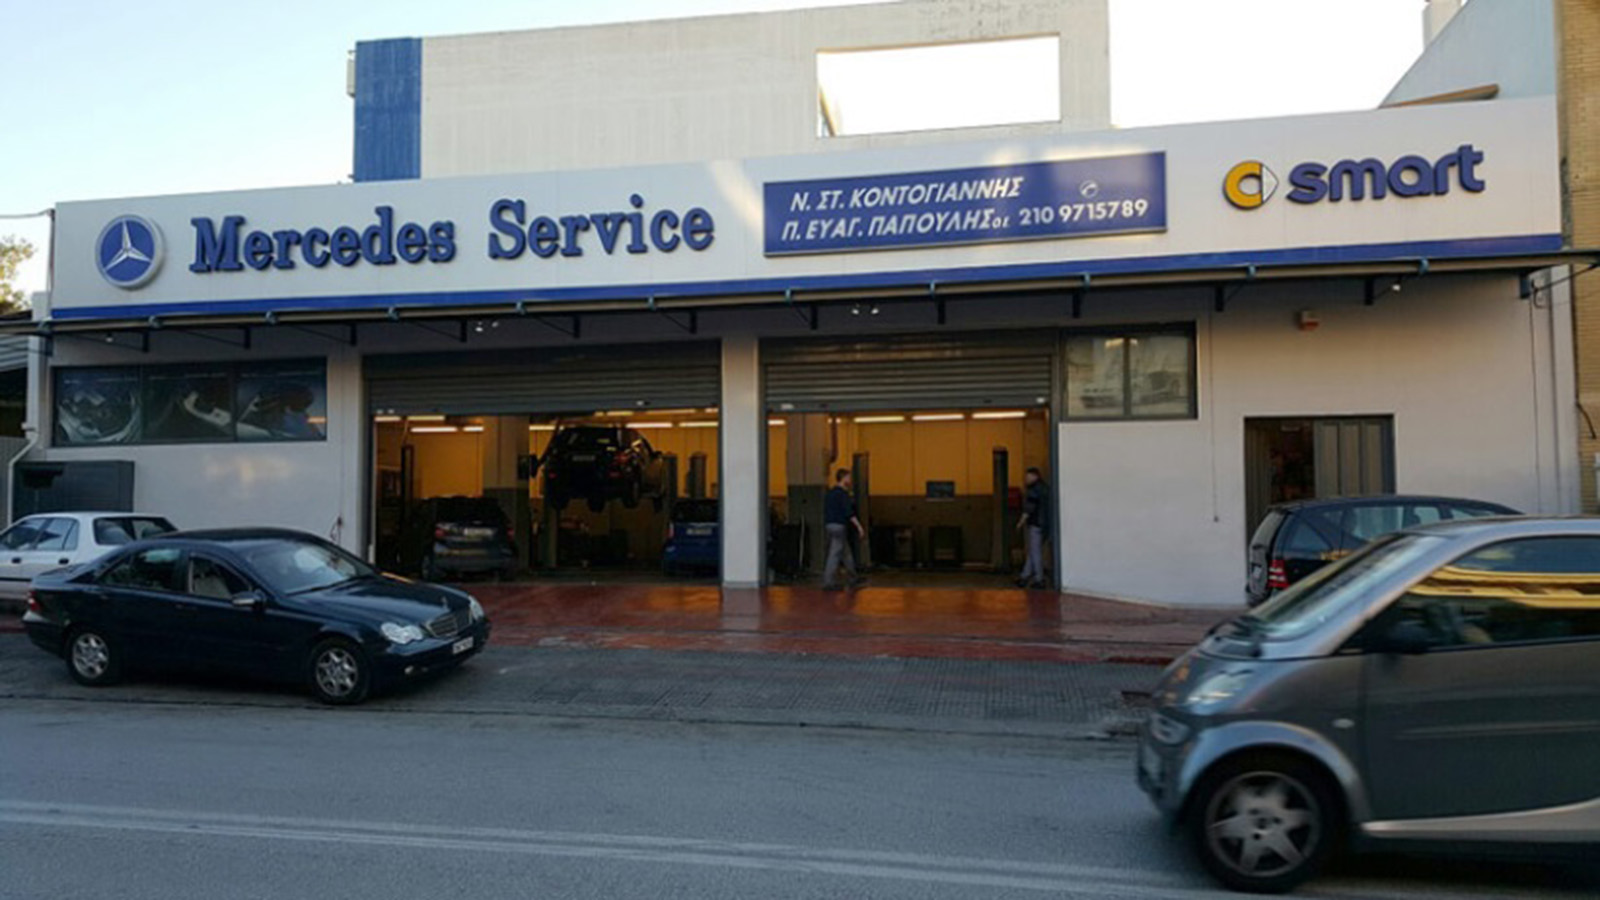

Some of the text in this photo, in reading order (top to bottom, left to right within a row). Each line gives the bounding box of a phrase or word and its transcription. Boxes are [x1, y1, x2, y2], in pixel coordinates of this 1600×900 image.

[1286, 144, 1485, 204] smart
[790, 176, 1024, 212] Ν. ΣΤ. ΚΟΝΤΟΓΙΑΝΝΗΣ
[1018, 198, 1148, 226] 210 9715789
[189, 194, 714, 273] Mercedes Service
[781, 220, 801, 241] Π.
[805, 217, 863, 240] ΕΥΑΓ.
